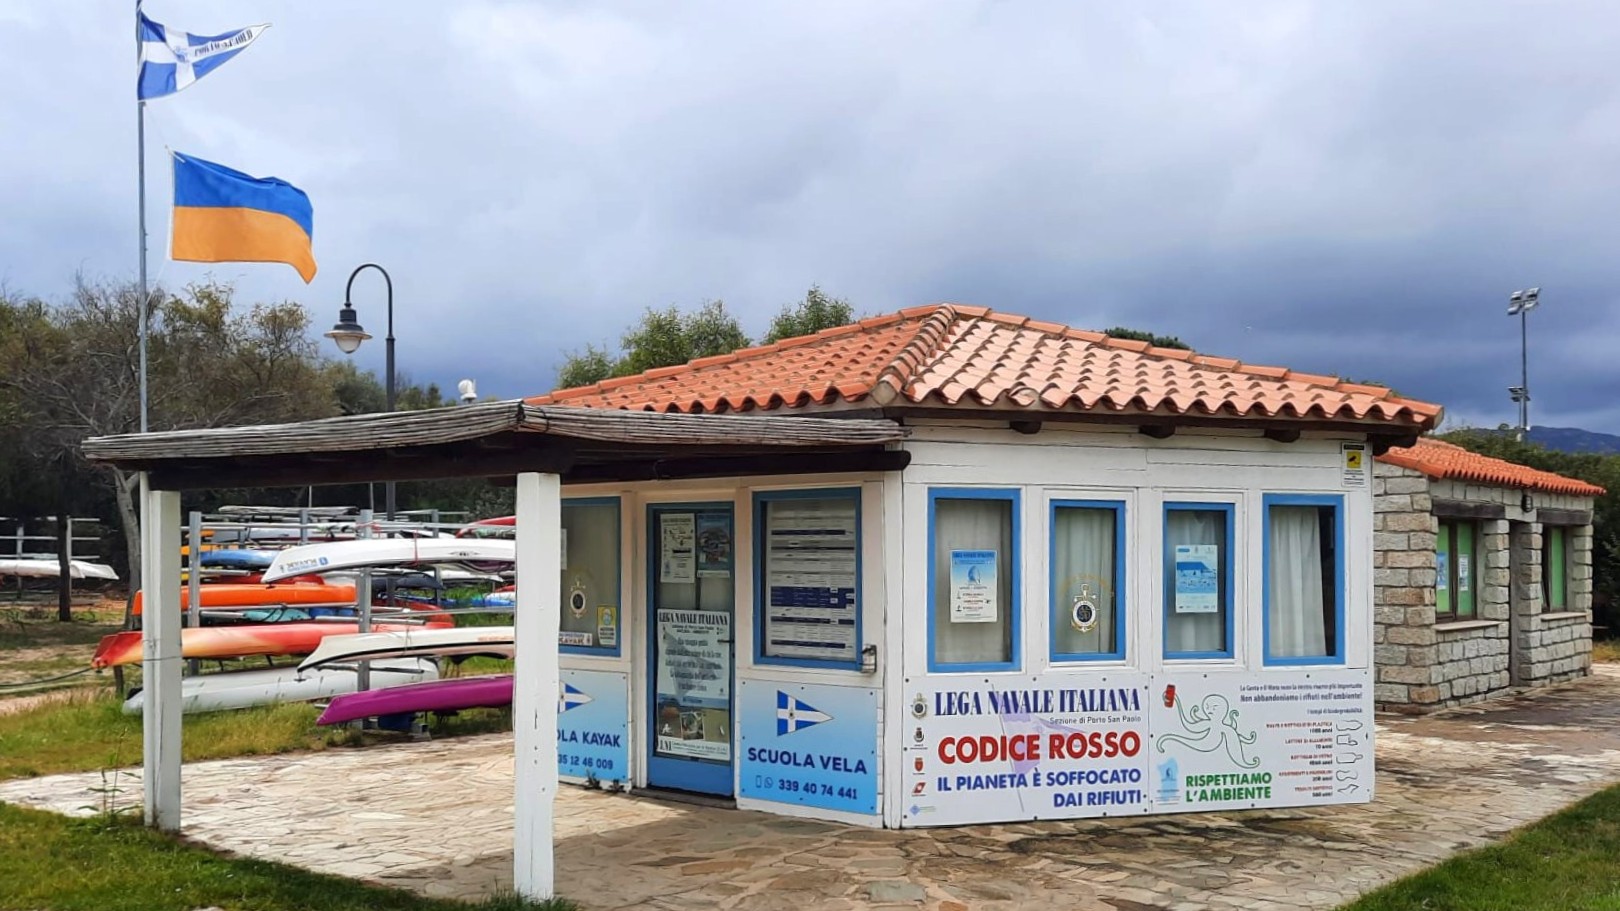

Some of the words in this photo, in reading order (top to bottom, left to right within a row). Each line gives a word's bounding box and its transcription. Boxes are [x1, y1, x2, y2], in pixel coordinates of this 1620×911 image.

[935, 691, 982, 716] LEGA
[987, 690, 1054, 716] NAVALE
[1059, 688, 1141, 713] ITALIANA
[1049, 717, 1077, 725] Sezione
[582, 731, 621, 748] KAYAK
[938, 734, 1040, 764] CODICE
[1048, 731, 1141, 760] ROSSO
[570, 755, 580, 766] 12
[596, 758, 613, 770] 009
[747, 747, 816, 769] SCUOLA
[819, 755, 868, 775] VELA
[937, 777, 952, 792] IL
[956, 773, 1028, 791] PIANETA
[1033, 767, 1041, 787] È
[1046, 768, 1141, 787] SOFFOCATO
[1185, 772, 1272, 787] RISPETTIAMO
[778, 779, 799, 792] 339
[803, 782, 817, 795] 40
[821, 784, 834, 796] 74
[837, 787, 857, 800] 441
[1185, 786, 1271, 802] L'AMBIENTE
[1053, 792, 1082, 808] DAI
[1086, 790, 1141, 806] RIFIUTI
